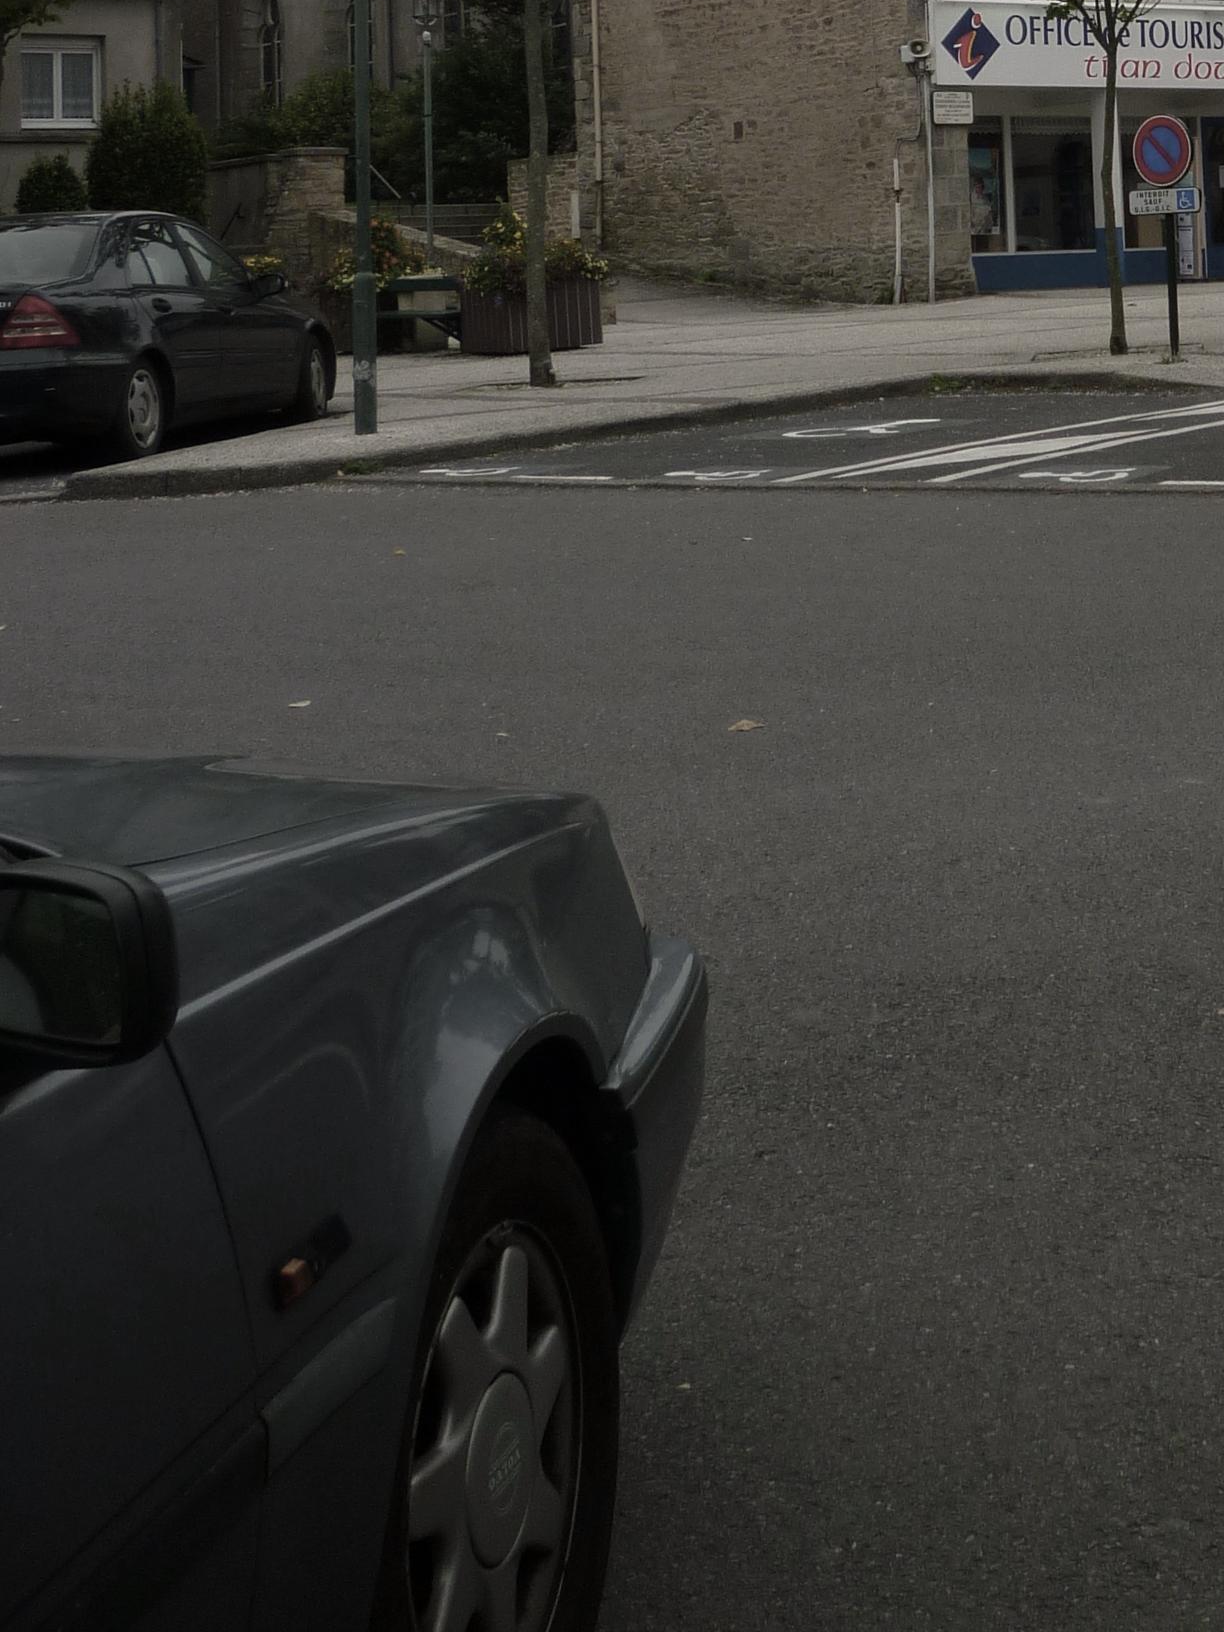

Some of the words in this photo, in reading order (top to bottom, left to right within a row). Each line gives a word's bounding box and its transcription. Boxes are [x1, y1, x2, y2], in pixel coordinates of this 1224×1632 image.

[1005, 14, 1095, 47] OFFICE
[1120, 58, 1161, 79] an
[1136, 190, 1169, 198] INTERDIT
